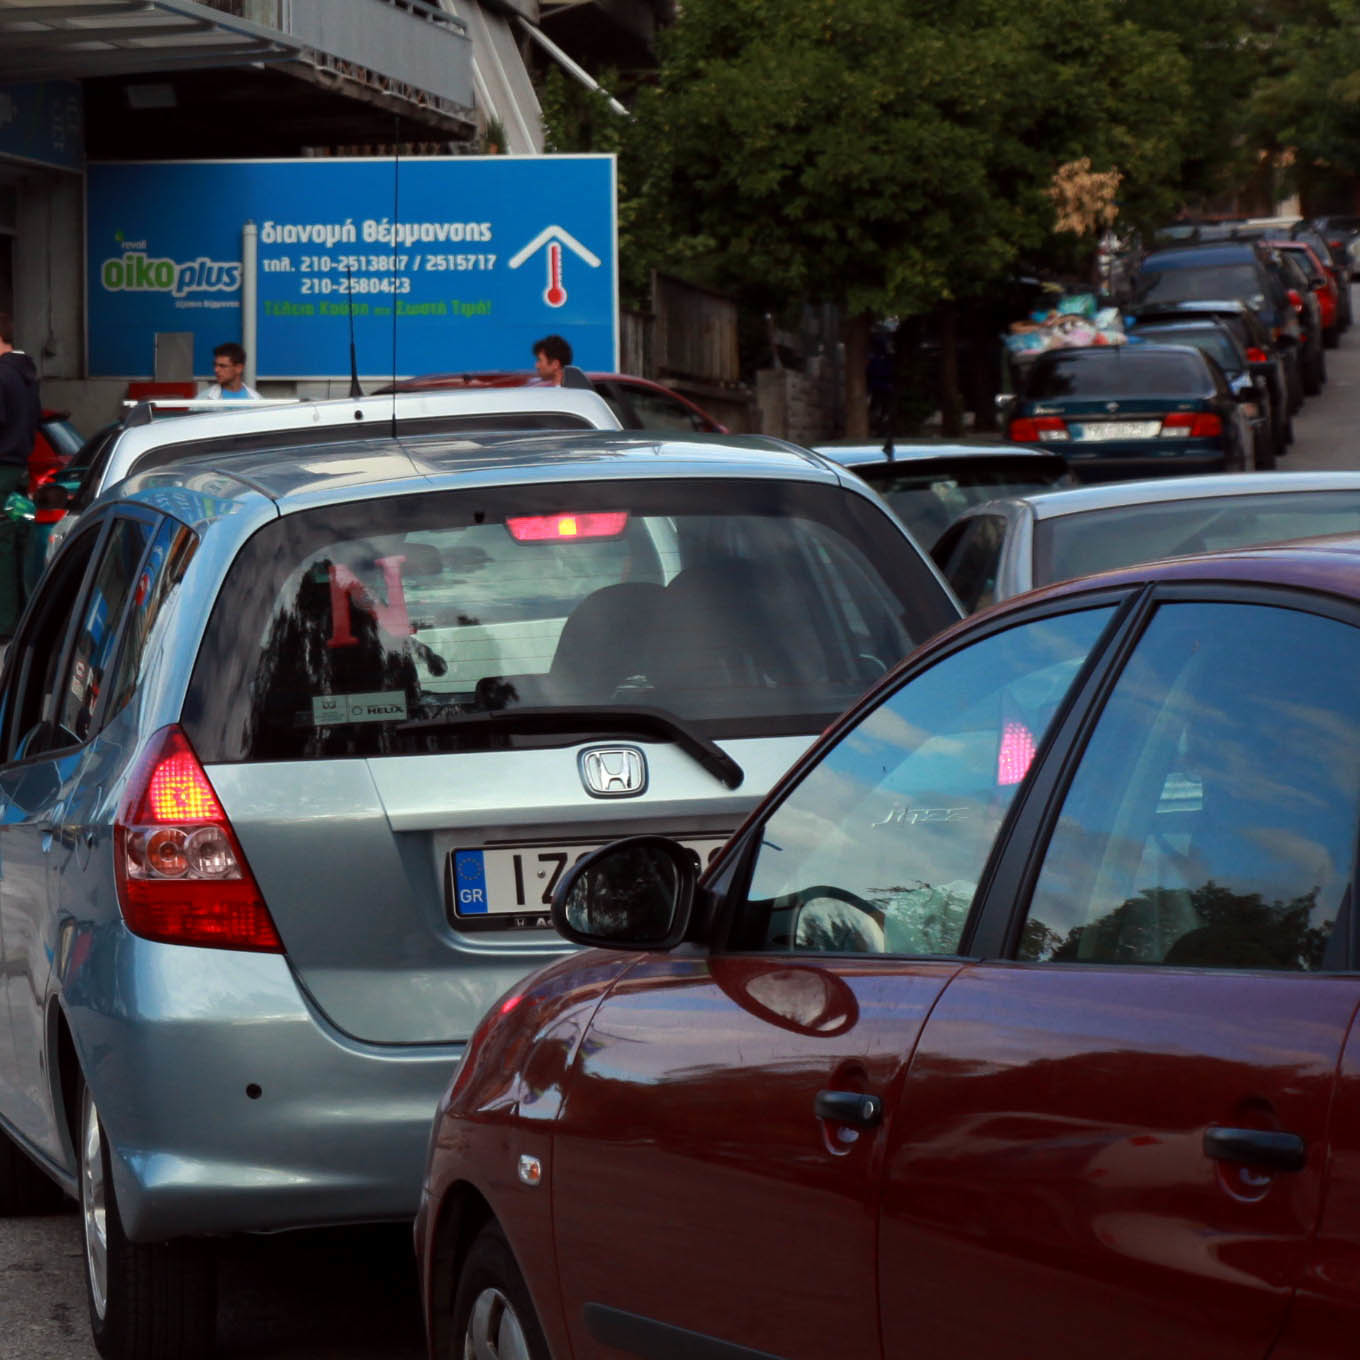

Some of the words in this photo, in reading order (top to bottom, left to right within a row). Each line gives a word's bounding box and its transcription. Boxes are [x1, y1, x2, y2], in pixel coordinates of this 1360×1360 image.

[261, 219, 357, 248] διανομή
[362, 218, 493, 247] θέρμανσης
[425, 254, 497, 271] 2515717
[102, 252, 242, 297] oikoplus
[367, 704, 405, 715] HELIX
[460, 888, 484, 904] GR
